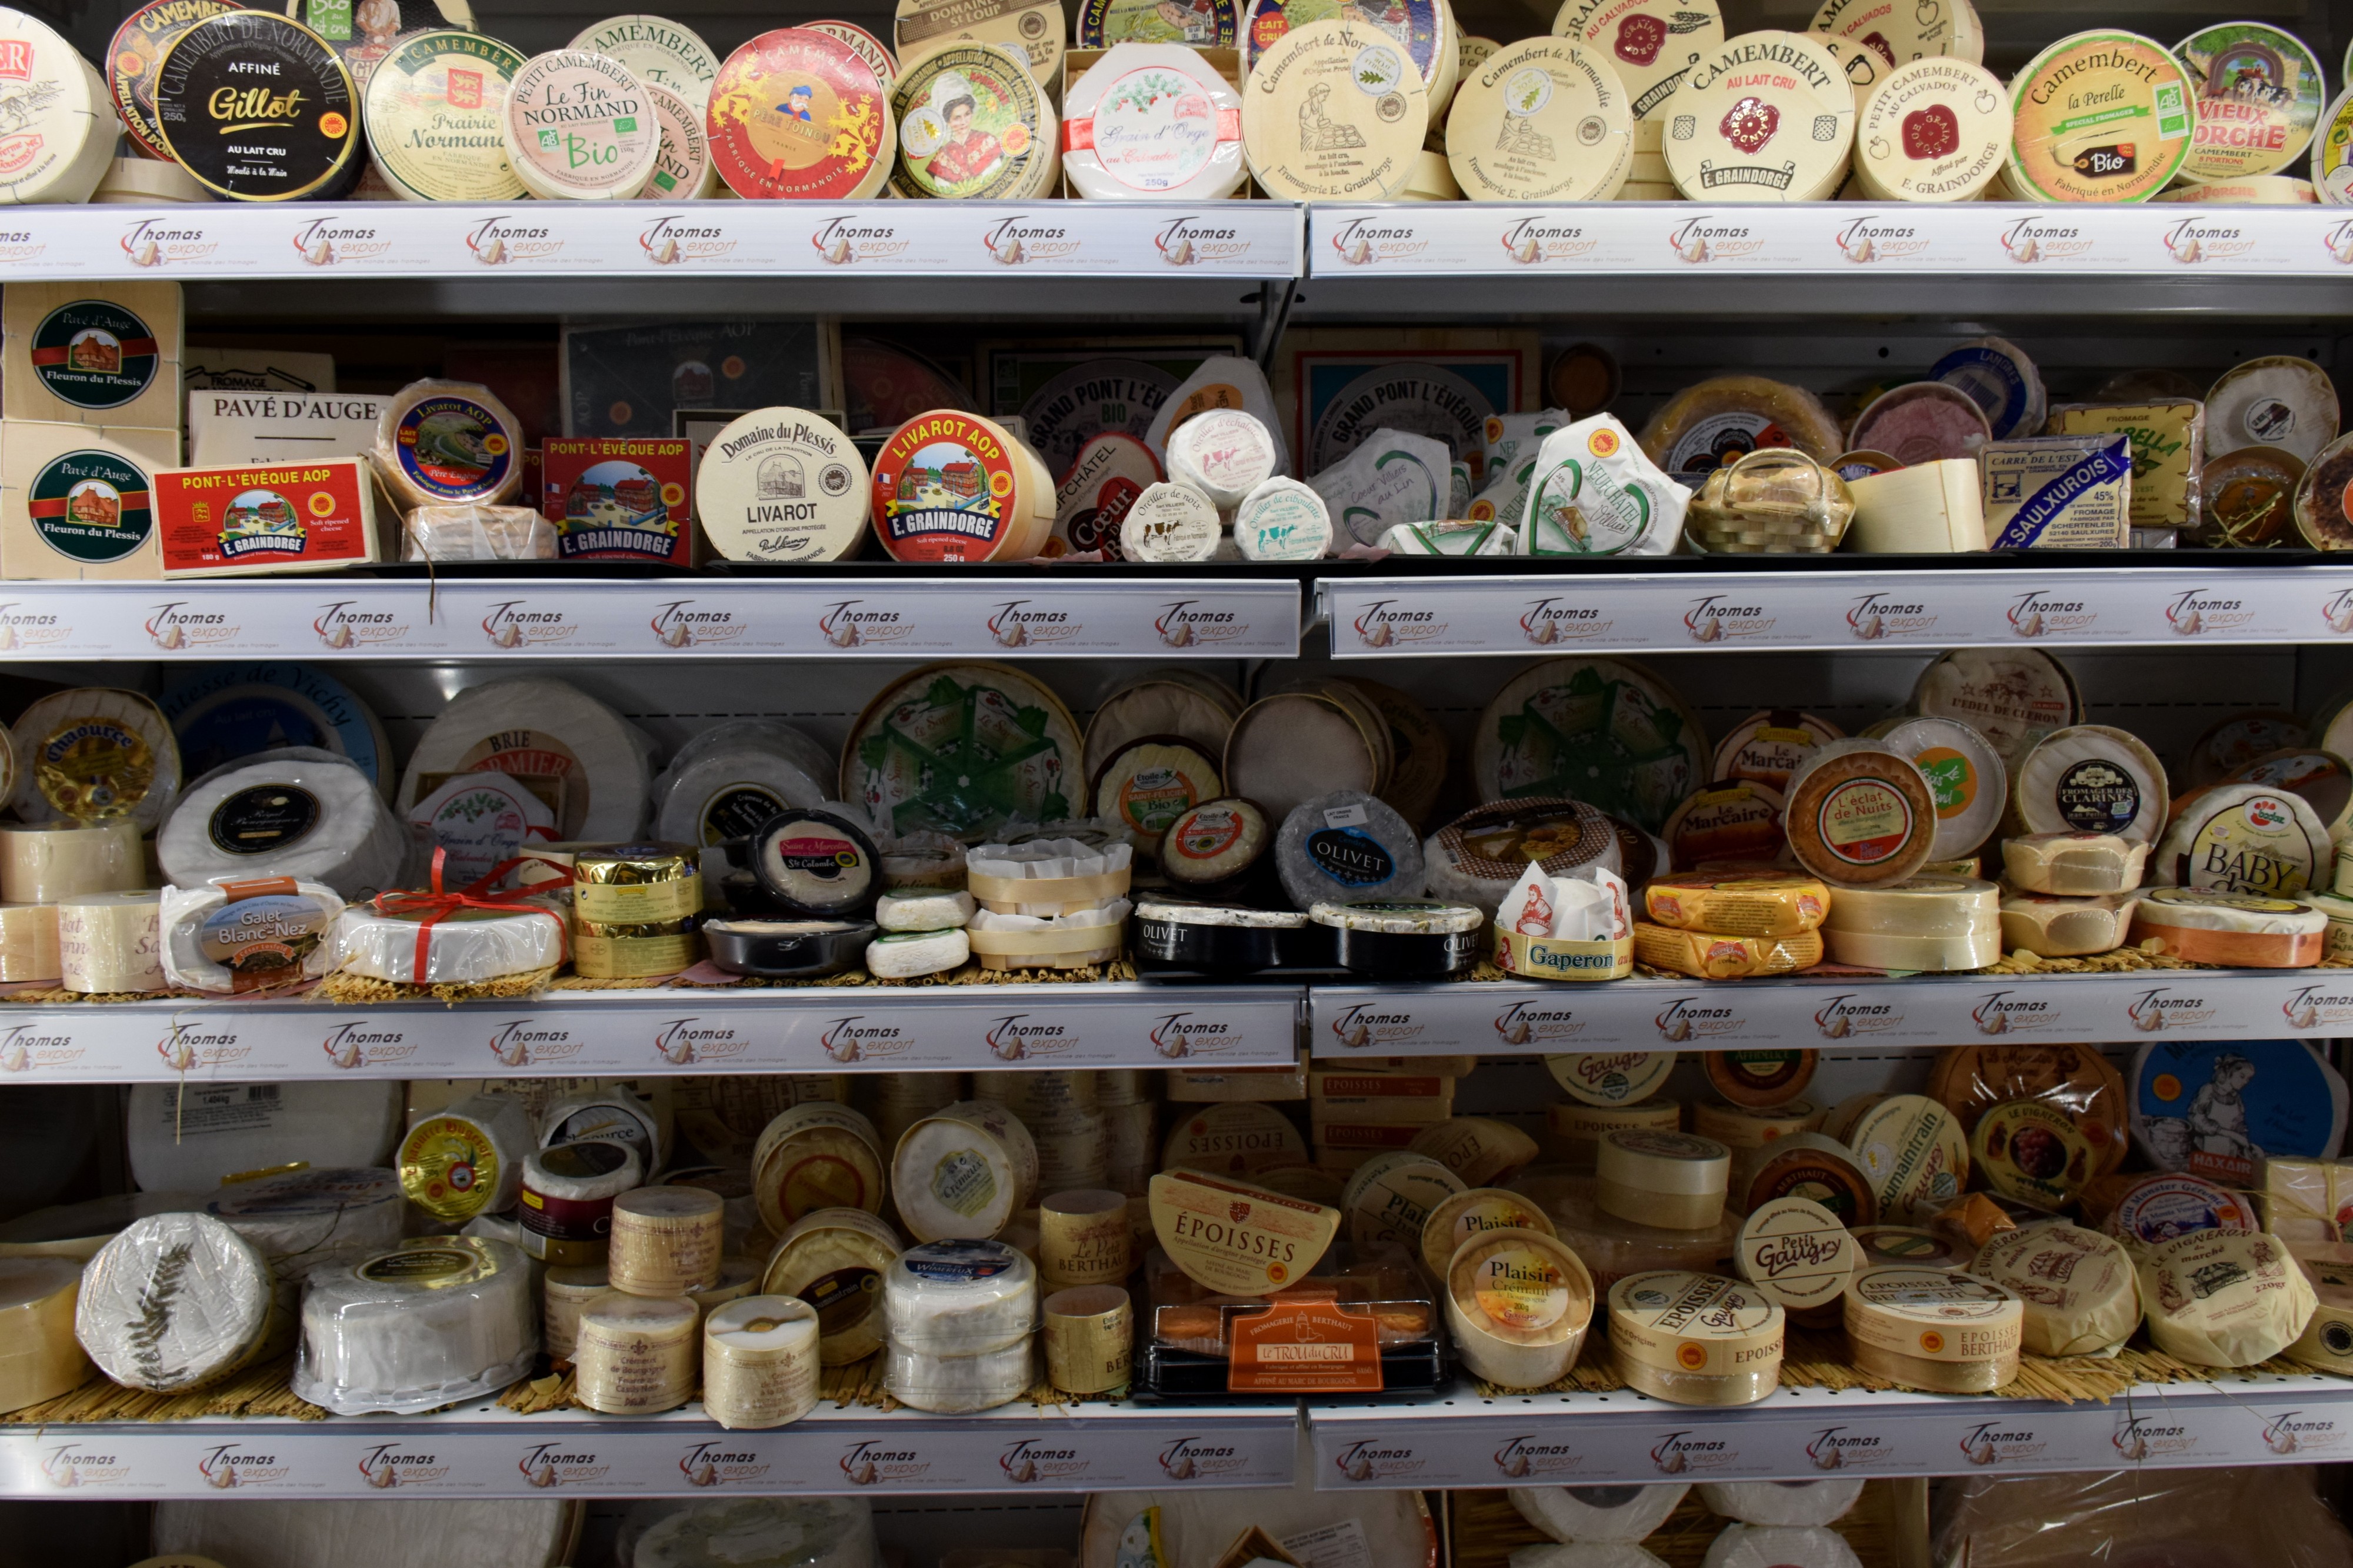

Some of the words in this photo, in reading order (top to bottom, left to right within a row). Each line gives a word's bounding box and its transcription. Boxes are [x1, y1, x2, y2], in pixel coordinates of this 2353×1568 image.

[1258, 21, 1284, 29] LAIT
[228, 62, 281, 76] AFFINÉ
[765, 44, 860, 90] CAMEMBERT
[1261, 35, 1321, 95] Camembert
[1693, 43, 1831, 91] CAMEMBERT
[516, 65, 548, 105] PETIT
[545, 55, 638, 94] CAMEMBERT
[1481, 49, 1549, 88] Camembert
[1566, 48, 1611, 109] Normandie
[1727, 76, 1742, 89] AU
[1745, 74, 1771, 86] LAIT
[1772, 75, 1797, 89] CRU
[2031, 49, 2158, 106] Camembert
[208, 86, 311, 121] Gillot
[545, 84, 571, 106] Le
[1869, 90, 1892, 130] PETIT
[1891, 66, 1979, 91] CAMEMBERT
[1899, 82, 1958, 103] CALVADOS
[2068, 94, 2079, 110] la
[2083, 84, 2125, 106] Perelle
[431, 113, 498, 130] Prairie
[522, 99, 638, 126] NORMAND
[2065, 117, 2095, 128] SPECIAL
[2095, 108, 2135, 123] FROMAGER
[2197, 100, 2270, 125] VIEUX
[753, 106, 784, 129] PÈRE
[785, 119, 831, 145] TOINOU
[1100, 126, 1151, 148] Grain
[227, 146, 242, 155] AU
[243, 146, 265, 156] LAIT
[266, 148, 286, 156] CRU
[561, 131, 618, 170] Bio
[619, 146, 635, 154] 150g
[2194, 148, 2252, 158] CAMEMBERT
[2205, 156, 2244, 165] PORTIONS
[268, 166, 288, 177] Main
[1916, 142, 1999, 195] GRAINDORGE
[1931, 161, 1954, 177] Affiné
[1955, 155, 1968, 169] par
[2090, 152, 2125, 173] Bio
[777, 165, 843, 194] NORMANDIE
[1144, 178, 1168, 187] 250g
[1277, 165, 1328, 195] Fromagerie
[1344, 156, 1393, 194] Graindorge
[1468, 155, 1506, 196] Fromagerie
[1521, 176, 1574, 201] Graindorge
[1715, 169, 1789, 189] GRAINDORGE
[2054, 177, 2099, 198] Fabriqué
[2117, 151, 2166, 192] Normandie
[298, 216, 376, 254] Thomas
[988, 215, 1066, 253] Thomas
[2005, 215, 2080, 252] Thomas
[340, 239, 392, 255] export
[1030, 238, 1082, 253] export
[2045, 238, 2095, 253] export
[62, 312, 89, 327] Pavé
[92, 315, 131, 331] d'Auge
[46, 371, 86, 384] Fleuron
[106, 375, 142, 388] Plessis
[1377, 379, 1418, 405] PONT
[214, 396, 278, 418] PAVÉ
[283, 399, 378, 421] D'AUGE
[416, 402, 462, 419] Livarot
[465, 405, 494, 428] AOP
[1101, 403, 1126, 424] BIO
[2106, 415, 2150, 423] FROMAGE
[549, 442, 654, 456] PONT-L'ÉVÊQUE
[657, 443, 684, 456] AOP
[719, 426, 776, 459] Domaine
[792, 422, 838, 456] Plessis
[892, 418, 968, 460] LIVAROT
[968, 427, 1001, 461] AOP
[1991, 453, 2028, 467] CARRE
[2047, 454, 2079, 464] L'EST
[182, 471, 300, 491] PONT-L'ÉVÊQUE
[302, 469, 331, 484] AOP
[1138, 489, 1171, 517] Oreiller
[1584, 459, 1641, 528] NEUFCHÂTEL
[2009, 458, 2108, 543] SAULXUROIS
[2093, 491, 2114, 501] 45%
[746, 503, 818, 524] LIVAROT
[44, 522, 85, 536] Fleuron
[104, 528, 141, 542] Plessis
[742, 525, 775, 535] APPELLATION
[905, 511, 995, 539] GRAINDORGE
[2051, 522, 2115, 530] SCHERTENLEIB
[235, 535, 302, 555] GRAINDORGE
[578, 531, 671, 556] GRAINDORGE
[916, 536, 927, 545] Soft
[928, 536, 948, 546] ripened
[948, 537, 968, 546] cheese
[992, 599, 1068, 637] Thomas
[2012, 590, 2084, 626] Thomas
[2050, 612, 2098, 626] export
[149, 601, 226, 639] Thomas
[190, 623, 241, 639] export
[1032, 622, 1084, 638] export
[2012, 708, 2059, 725] CLERON
[45, 723, 135, 763] Chaource
[488, 731, 531, 753] BRIE
[1838, 791, 1883, 809] L'éclat
[2062, 787, 2113, 796] FROMAGER
[2062, 793, 2134, 803] CLARINES
[1147, 798, 1171, 810] Bio
[1834, 808, 1852, 821] de
[1855, 800, 1892, 816] Nuits
[1684, 806, 1770, 832] Marcaire
[1316, 841, 1386, 872] OLIVET
[2202, 841, 2298, 886] BABY
[240, 911, 283, 925] Galet
[218, 922, 308, 945] Blanc-Nez
[1143, 925, 1188, 942] OLIVET
[1529, 944, 1615, 973] Gaperon
[1977, 990, 2047, 1025] Thomas
[2015, 1011, 2061, 1025] export
[328, 1020, 404, 1057] Thomas
[990, 1013, 1065, 1050] Thomas
[368, 1043, 419, 1058] export
[1030, 1036, 1081, 1051] export
[1173, 1210, 1296, 1263] ÉPOISSES
[1781, 1235, 1817, 1250] Petit
[1755, 1238, 1842, 1277] Gaugry
[2180, 1245, 2225, 1264] marché
[1489, 1260, 1554, 1285] Plaisir
[1491, 1279, 1551, 1298] Crémant
[2252, 1280, 2287, 1293] 220gr
[1514, 1302, 1530, 1313] 200g
[1658, 1275, 1727, 1330] EPOISSES
[1249, 1316, 1294, 1336] FROMAGERIE
[1312, 1316, 1354, 1332] BERTHAUT
[1960, 1324, 2018, 1343] EPOISSES
[1274, 1345, 1309, 1360] TROU
[1323, 1345, 1348, 1360] CRU
[1960, 1334, 2018, 1357] BERTHAUT
[1965, 1421, 2034, 1454] Thomas
[2002, 1441, 2048, 1455] export
[364, 1443, 435, 1478] Thomas
[1004, 1438, 1076, 1473] Thomas
[1042, 1459, 1091, 1474] export
[402, 1464, 450, 1479] export
